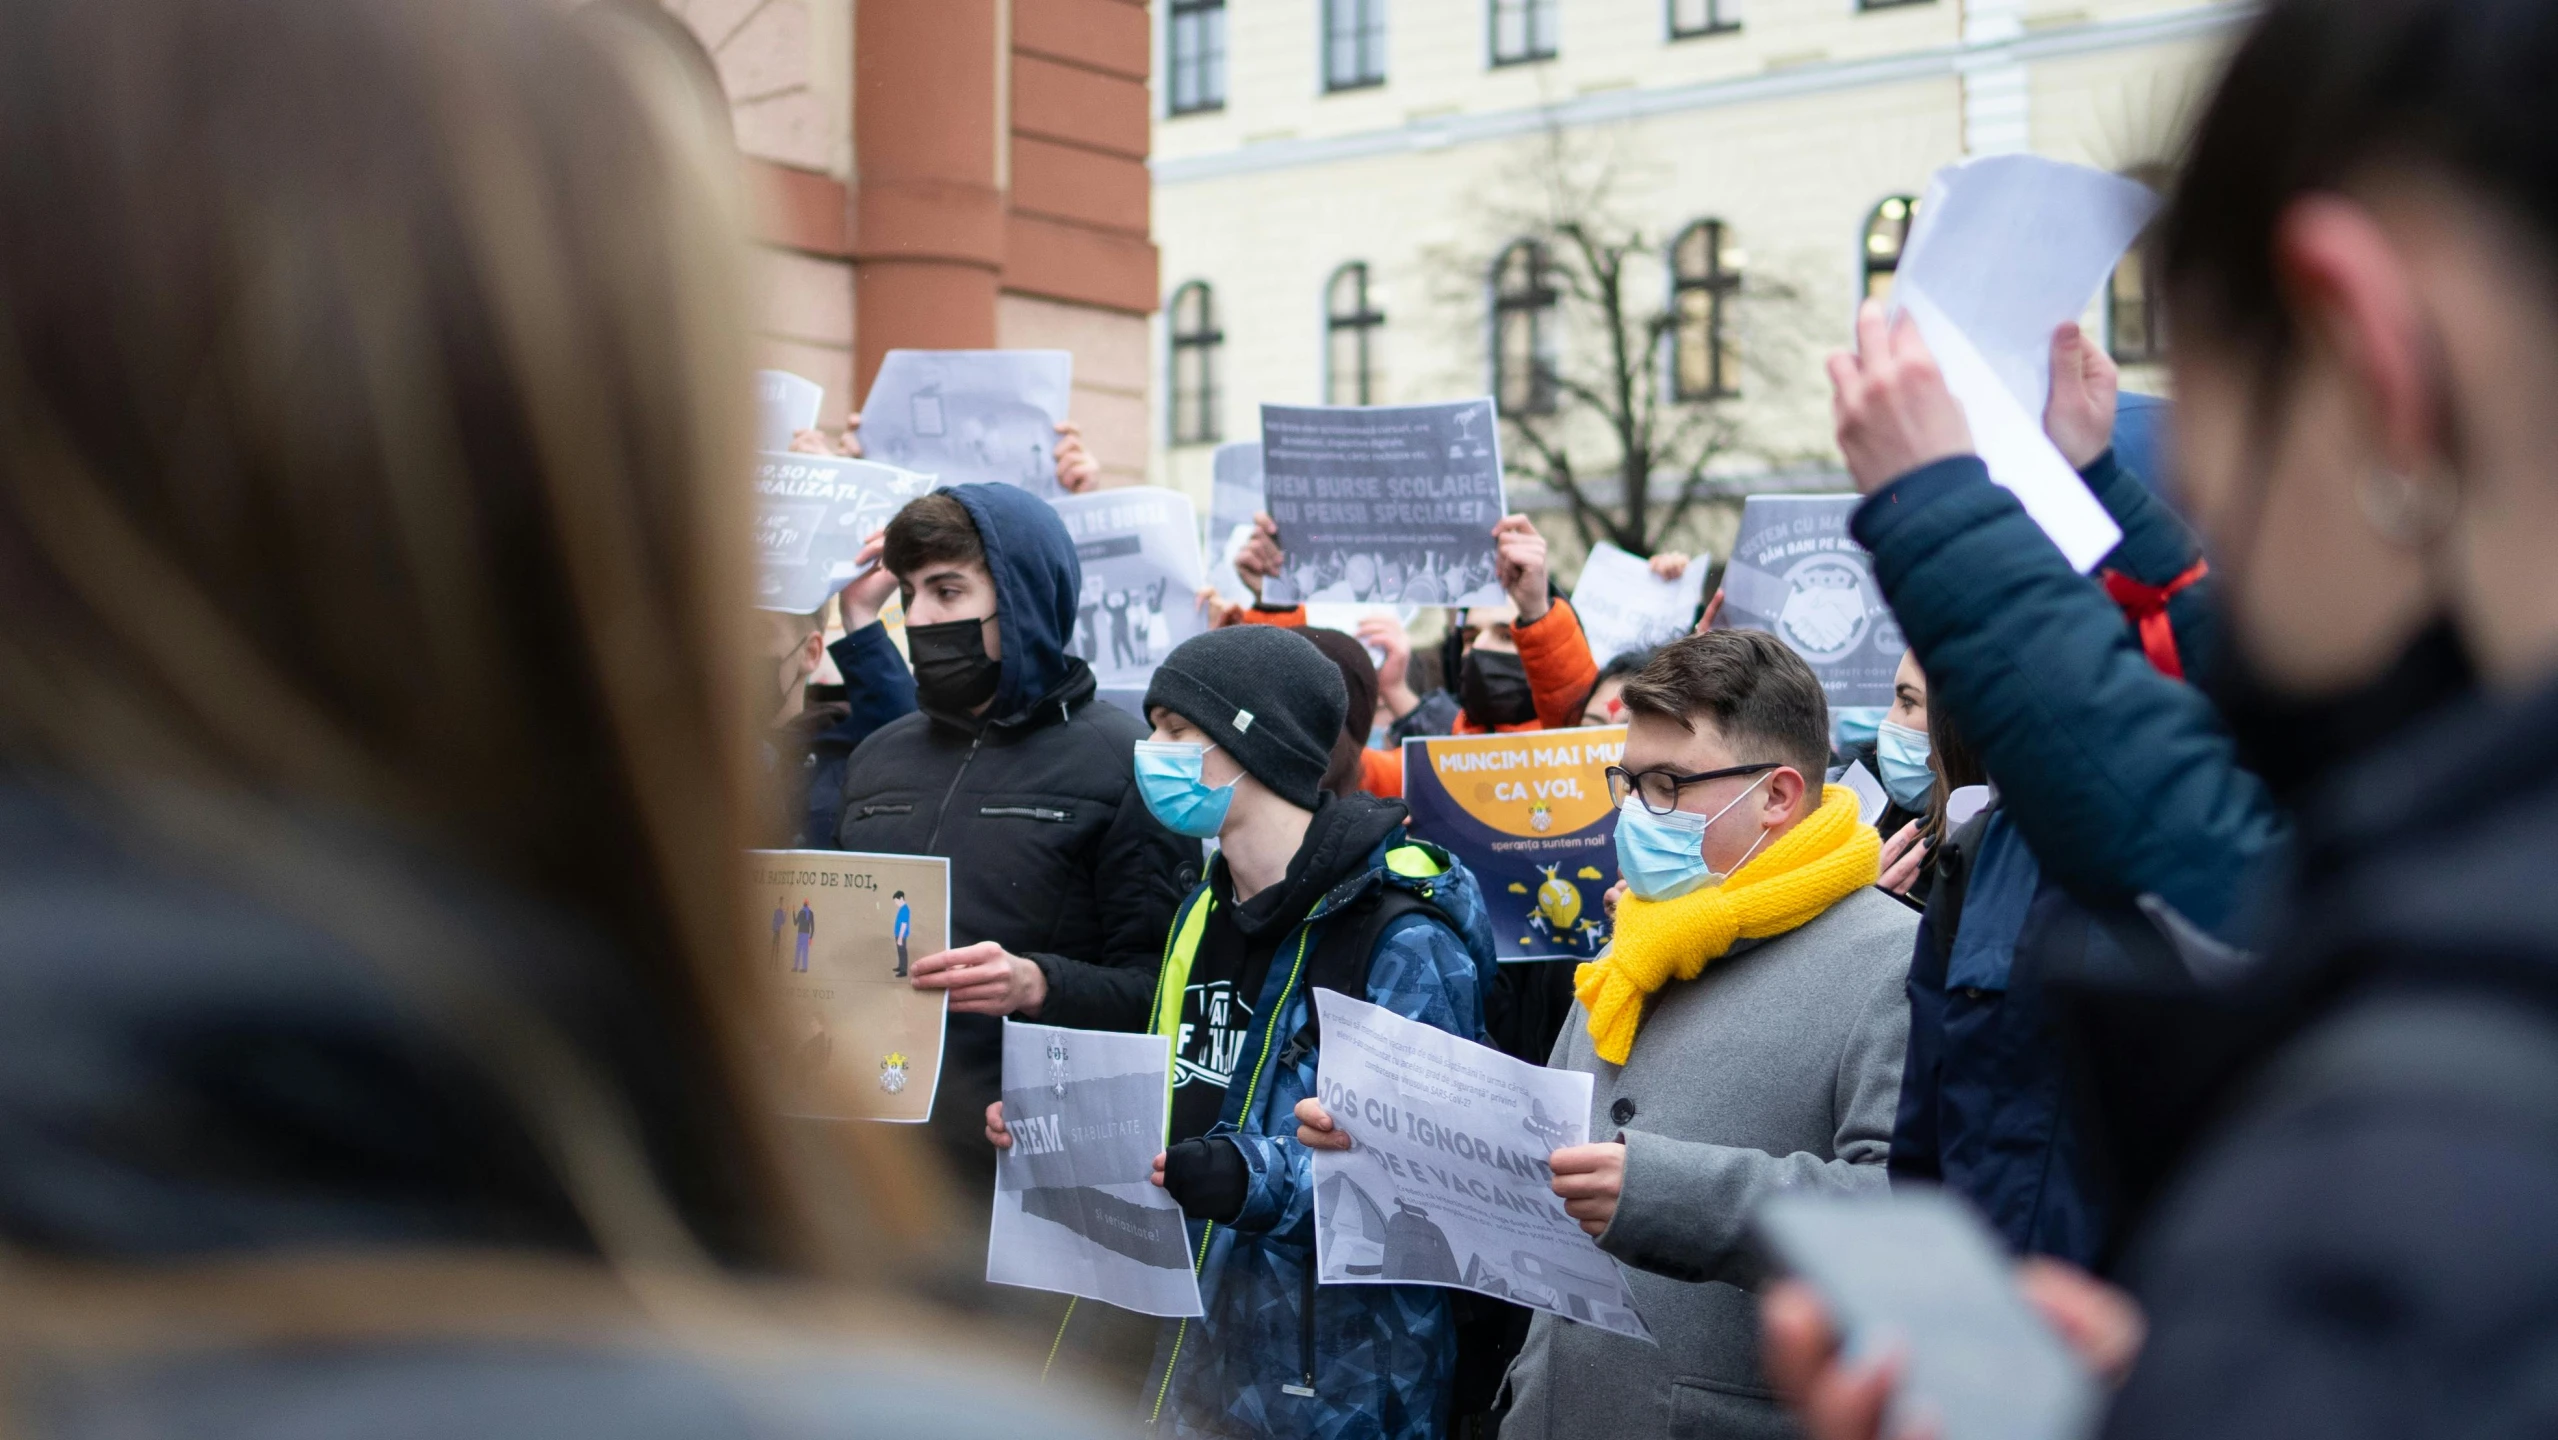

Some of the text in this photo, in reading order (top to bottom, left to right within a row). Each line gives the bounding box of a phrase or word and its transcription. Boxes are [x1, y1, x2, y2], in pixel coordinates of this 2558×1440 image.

[1316, 477, 1380, 499] BURSE
[1373, 501, 1485, 525] SPECIALE!
[1786, 538, 1816, 556] BANI
[1819, 536, 1836, 550] PE
[1439, 749, 1530, 773] MUNCIM
[1534, 745, 1581, 768] MAI
[1495, 778, 1585, 802] CA VOI,
[1491, 833, 1606, 854] speranța suntem noi!
[796, 871, 816, 886] JOC
[820, 872, 839, 887] DE
[844, 873, 879, 892] NOI,
[1417, 1048, 1427, 1060] de
[1479, 1070, 1486, 1081] în
[1487, 1075, 1507, 1089] urma
[1392, 1057, 1400, 1066] cu
[1425, 1069, 1441, 1081] grad
[1441, 1074, 1450, 1085] de
[1491, 1092, 1517, 1108] privind
[1318, 1075, 1359, 1119] JOS
[1364, 1098, 1399, 1134] CU
[1430, 1086, 1472, 1108] SARS-CoV-2?
[1406, 1158, 1430, 1185] E
[1104, 1213, 1160, 1243] seriozitate!
